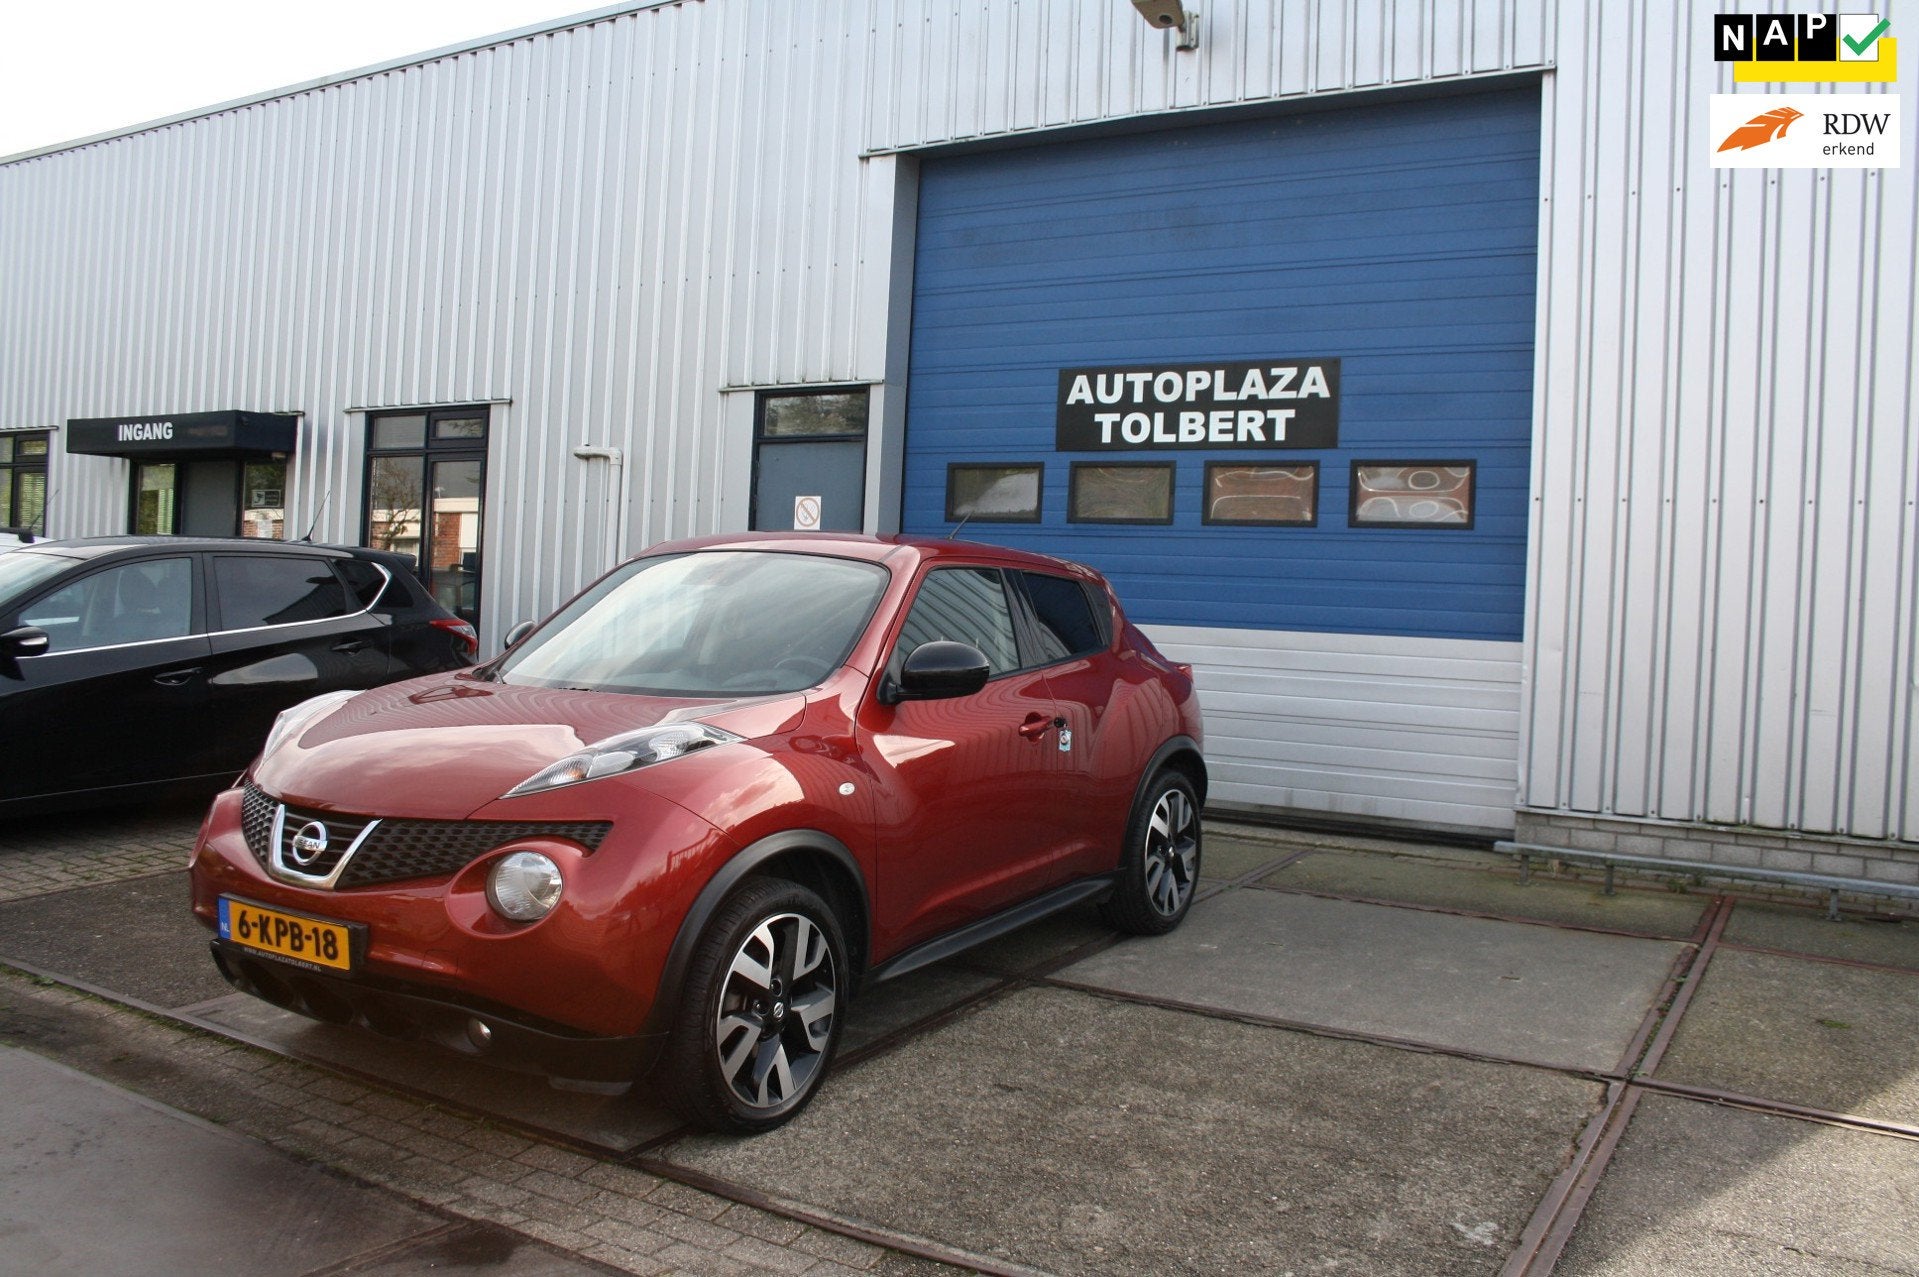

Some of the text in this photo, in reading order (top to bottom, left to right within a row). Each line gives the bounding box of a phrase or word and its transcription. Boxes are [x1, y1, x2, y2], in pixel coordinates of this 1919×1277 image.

[1066, 366, 1331, 405] AUTOPLAZA
[118, 421, 173, 441] INGANG
[1094, 409, 1296, 443] TOLBERT
[220, 910, 339, 961] NL 6-KPB-18
